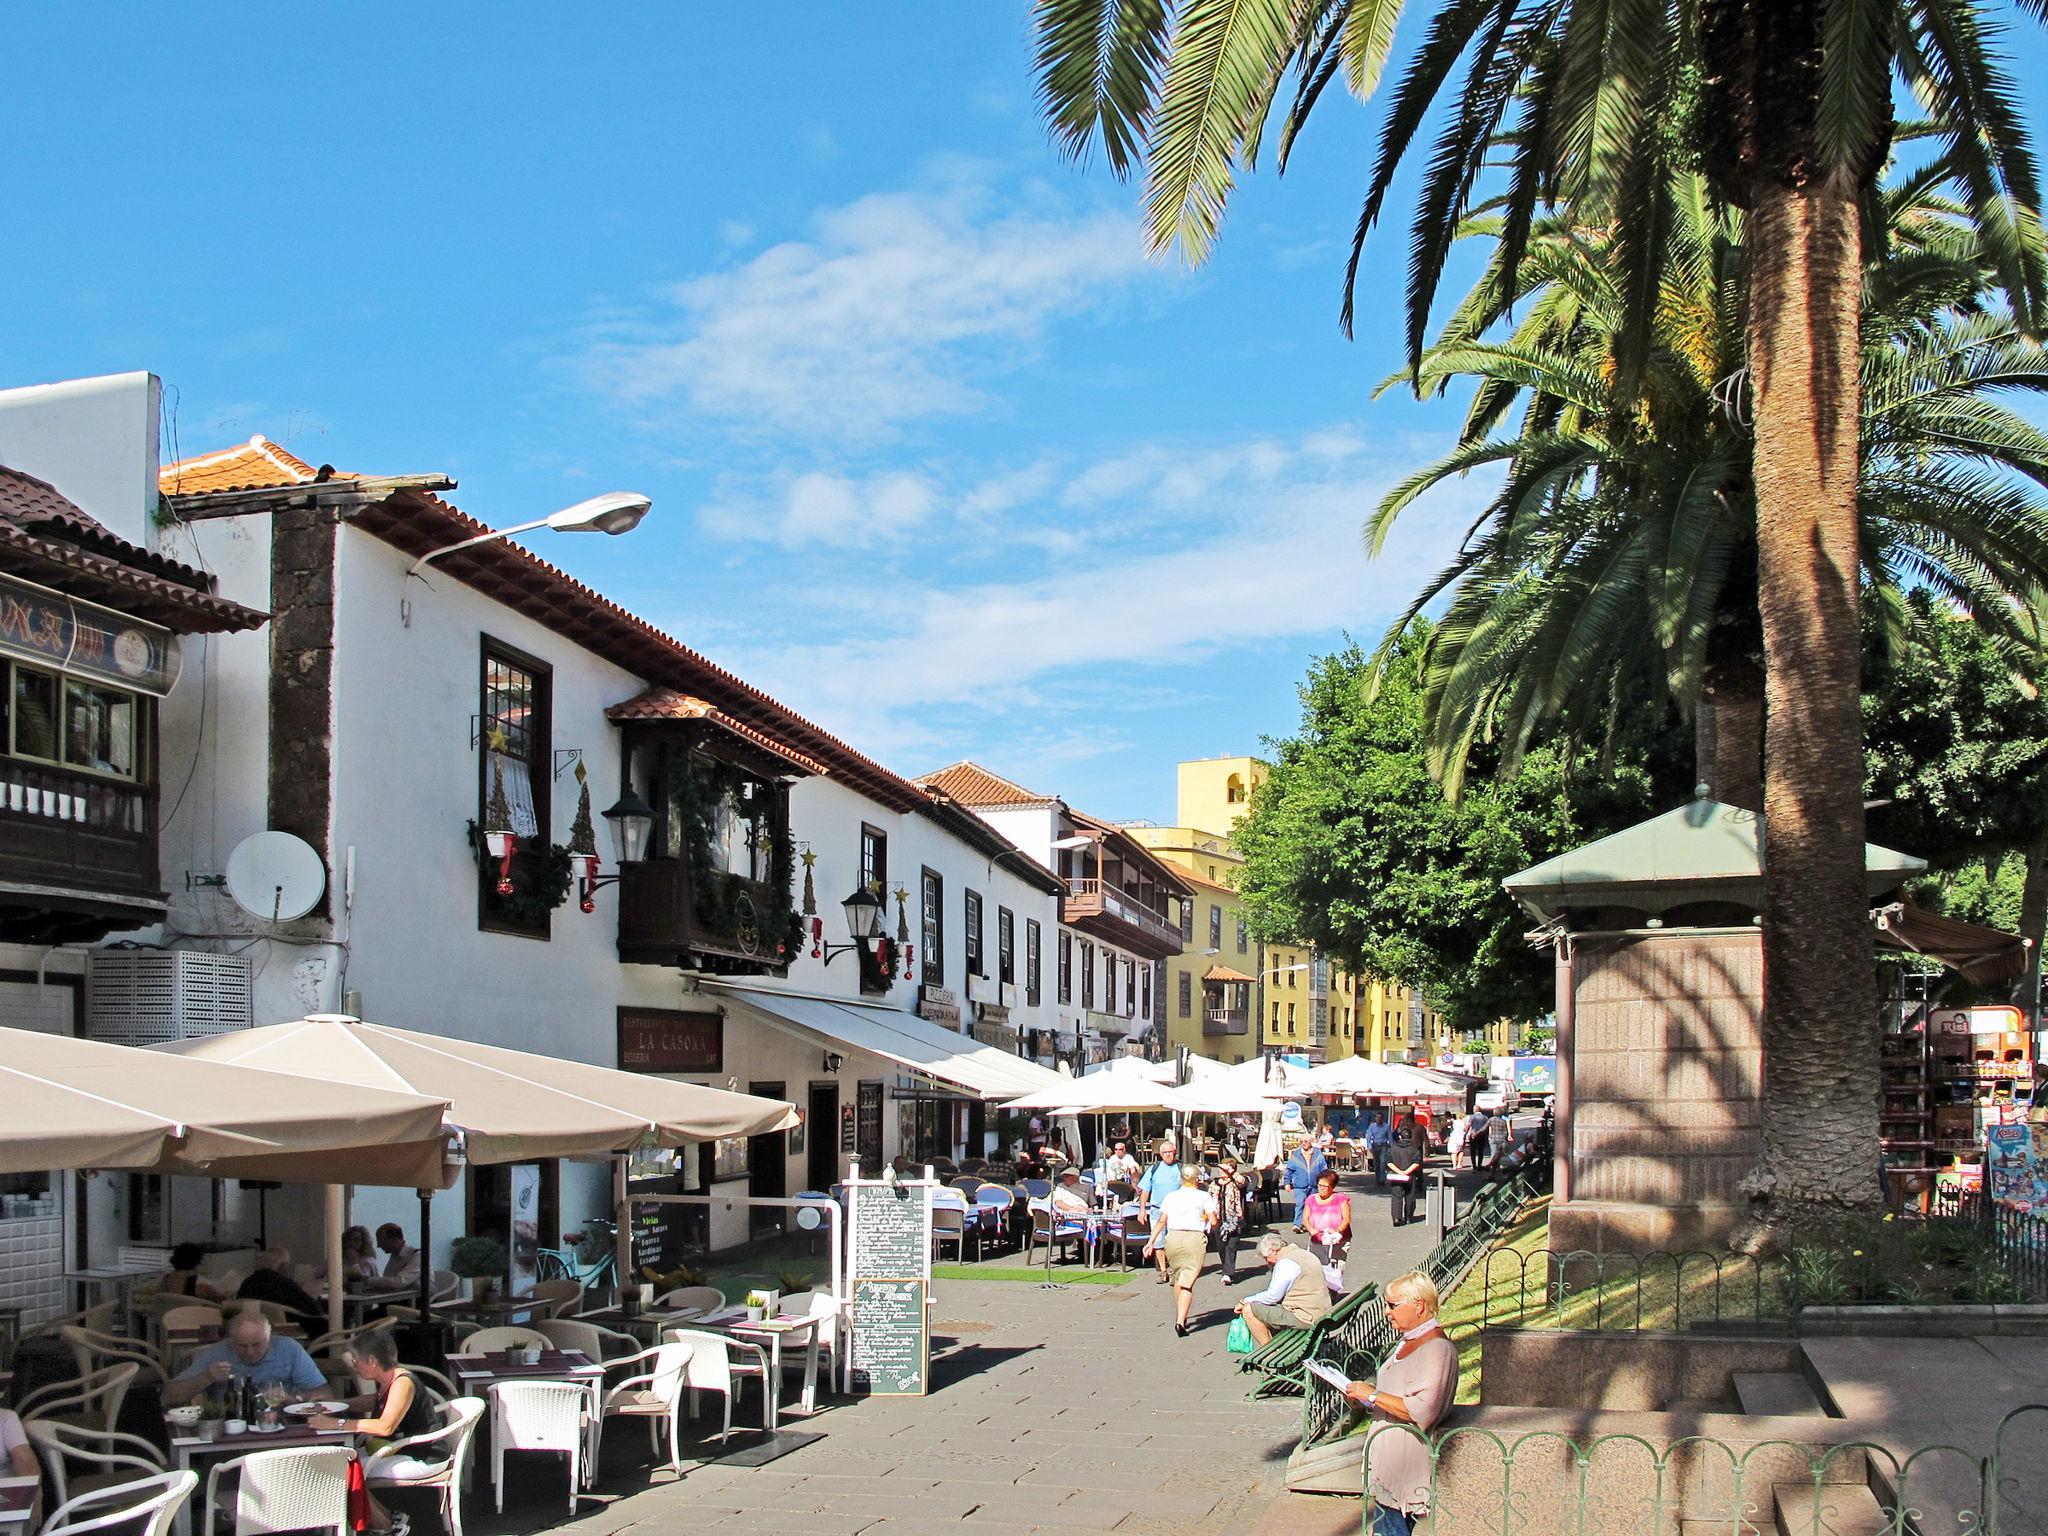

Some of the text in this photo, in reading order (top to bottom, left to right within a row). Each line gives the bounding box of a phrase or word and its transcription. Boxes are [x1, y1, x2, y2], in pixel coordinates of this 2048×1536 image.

[639, 1032, 706, 1051] LA CASONA
[1520, 1069, 1550, 1087] Sprite
